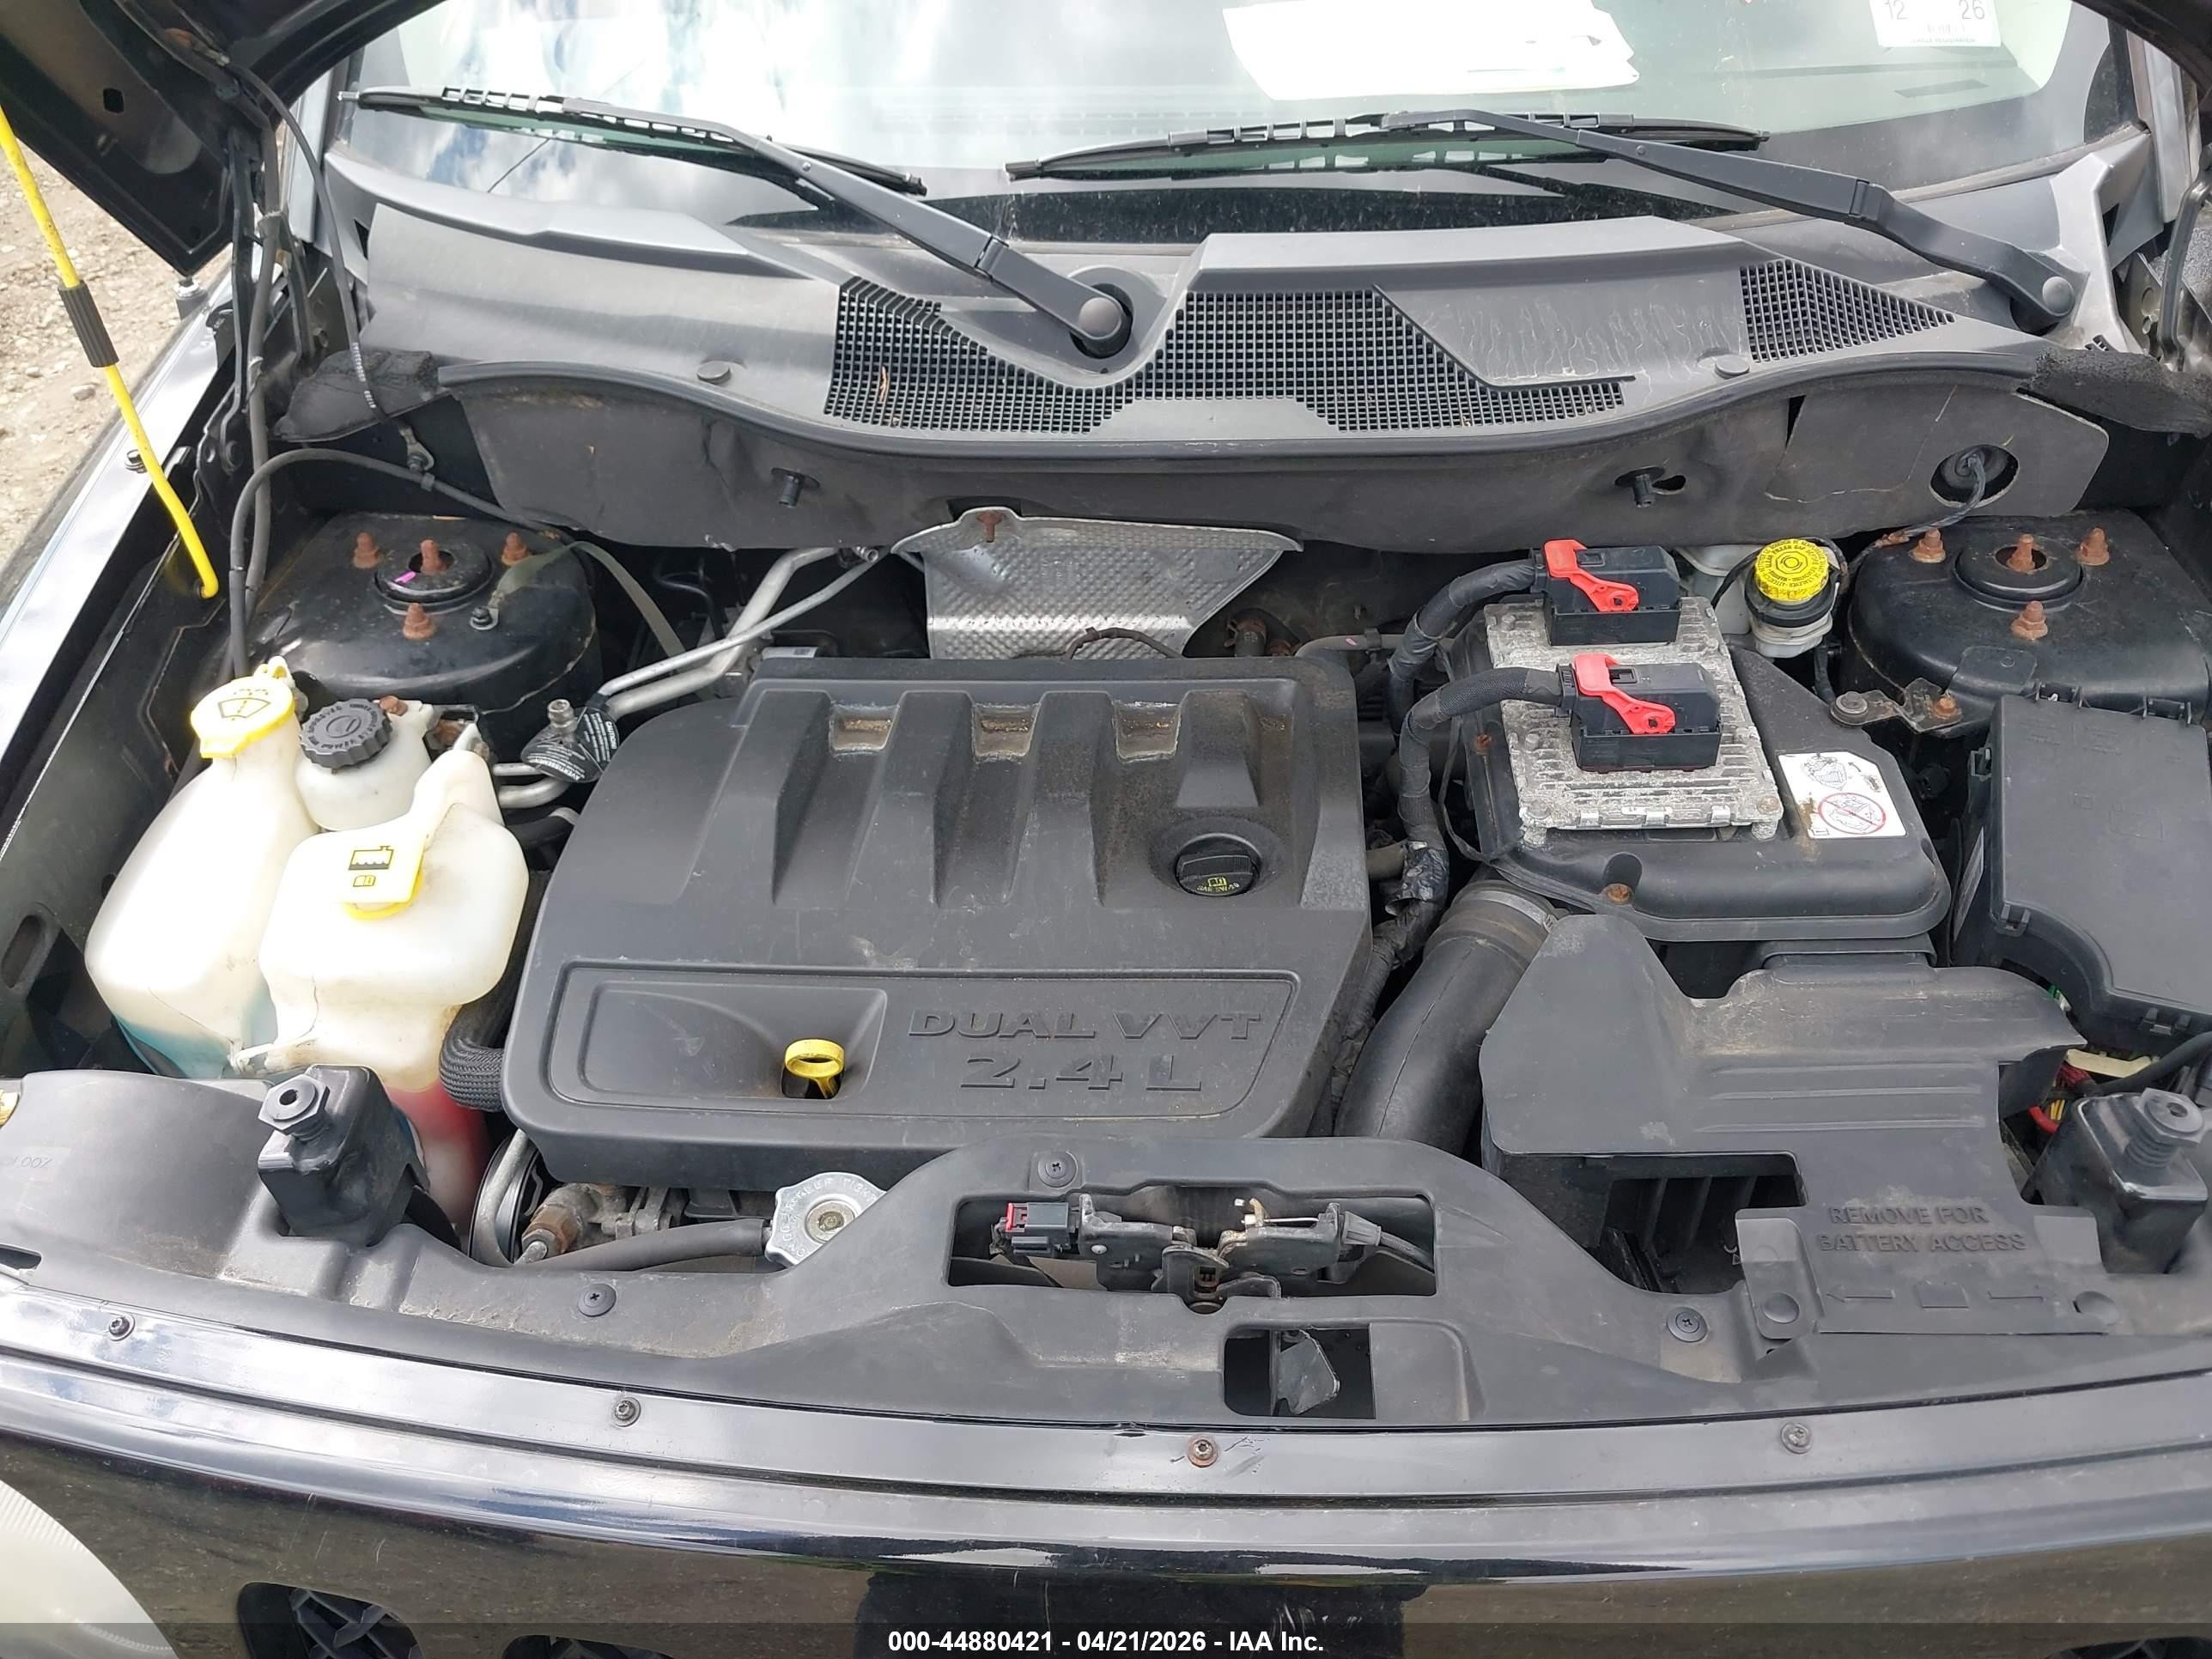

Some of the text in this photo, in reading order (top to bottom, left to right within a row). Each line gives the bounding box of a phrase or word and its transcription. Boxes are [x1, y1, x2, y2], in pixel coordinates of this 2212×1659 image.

[1959, 0, 1985, 20] 26
[908, 1012, 1262, 1040] DUAL VVT
[1829, 1206, 1990, 1224] REMOVE FOR
[1818, 1235, 2027, 1252] BATTERY ACCESS
